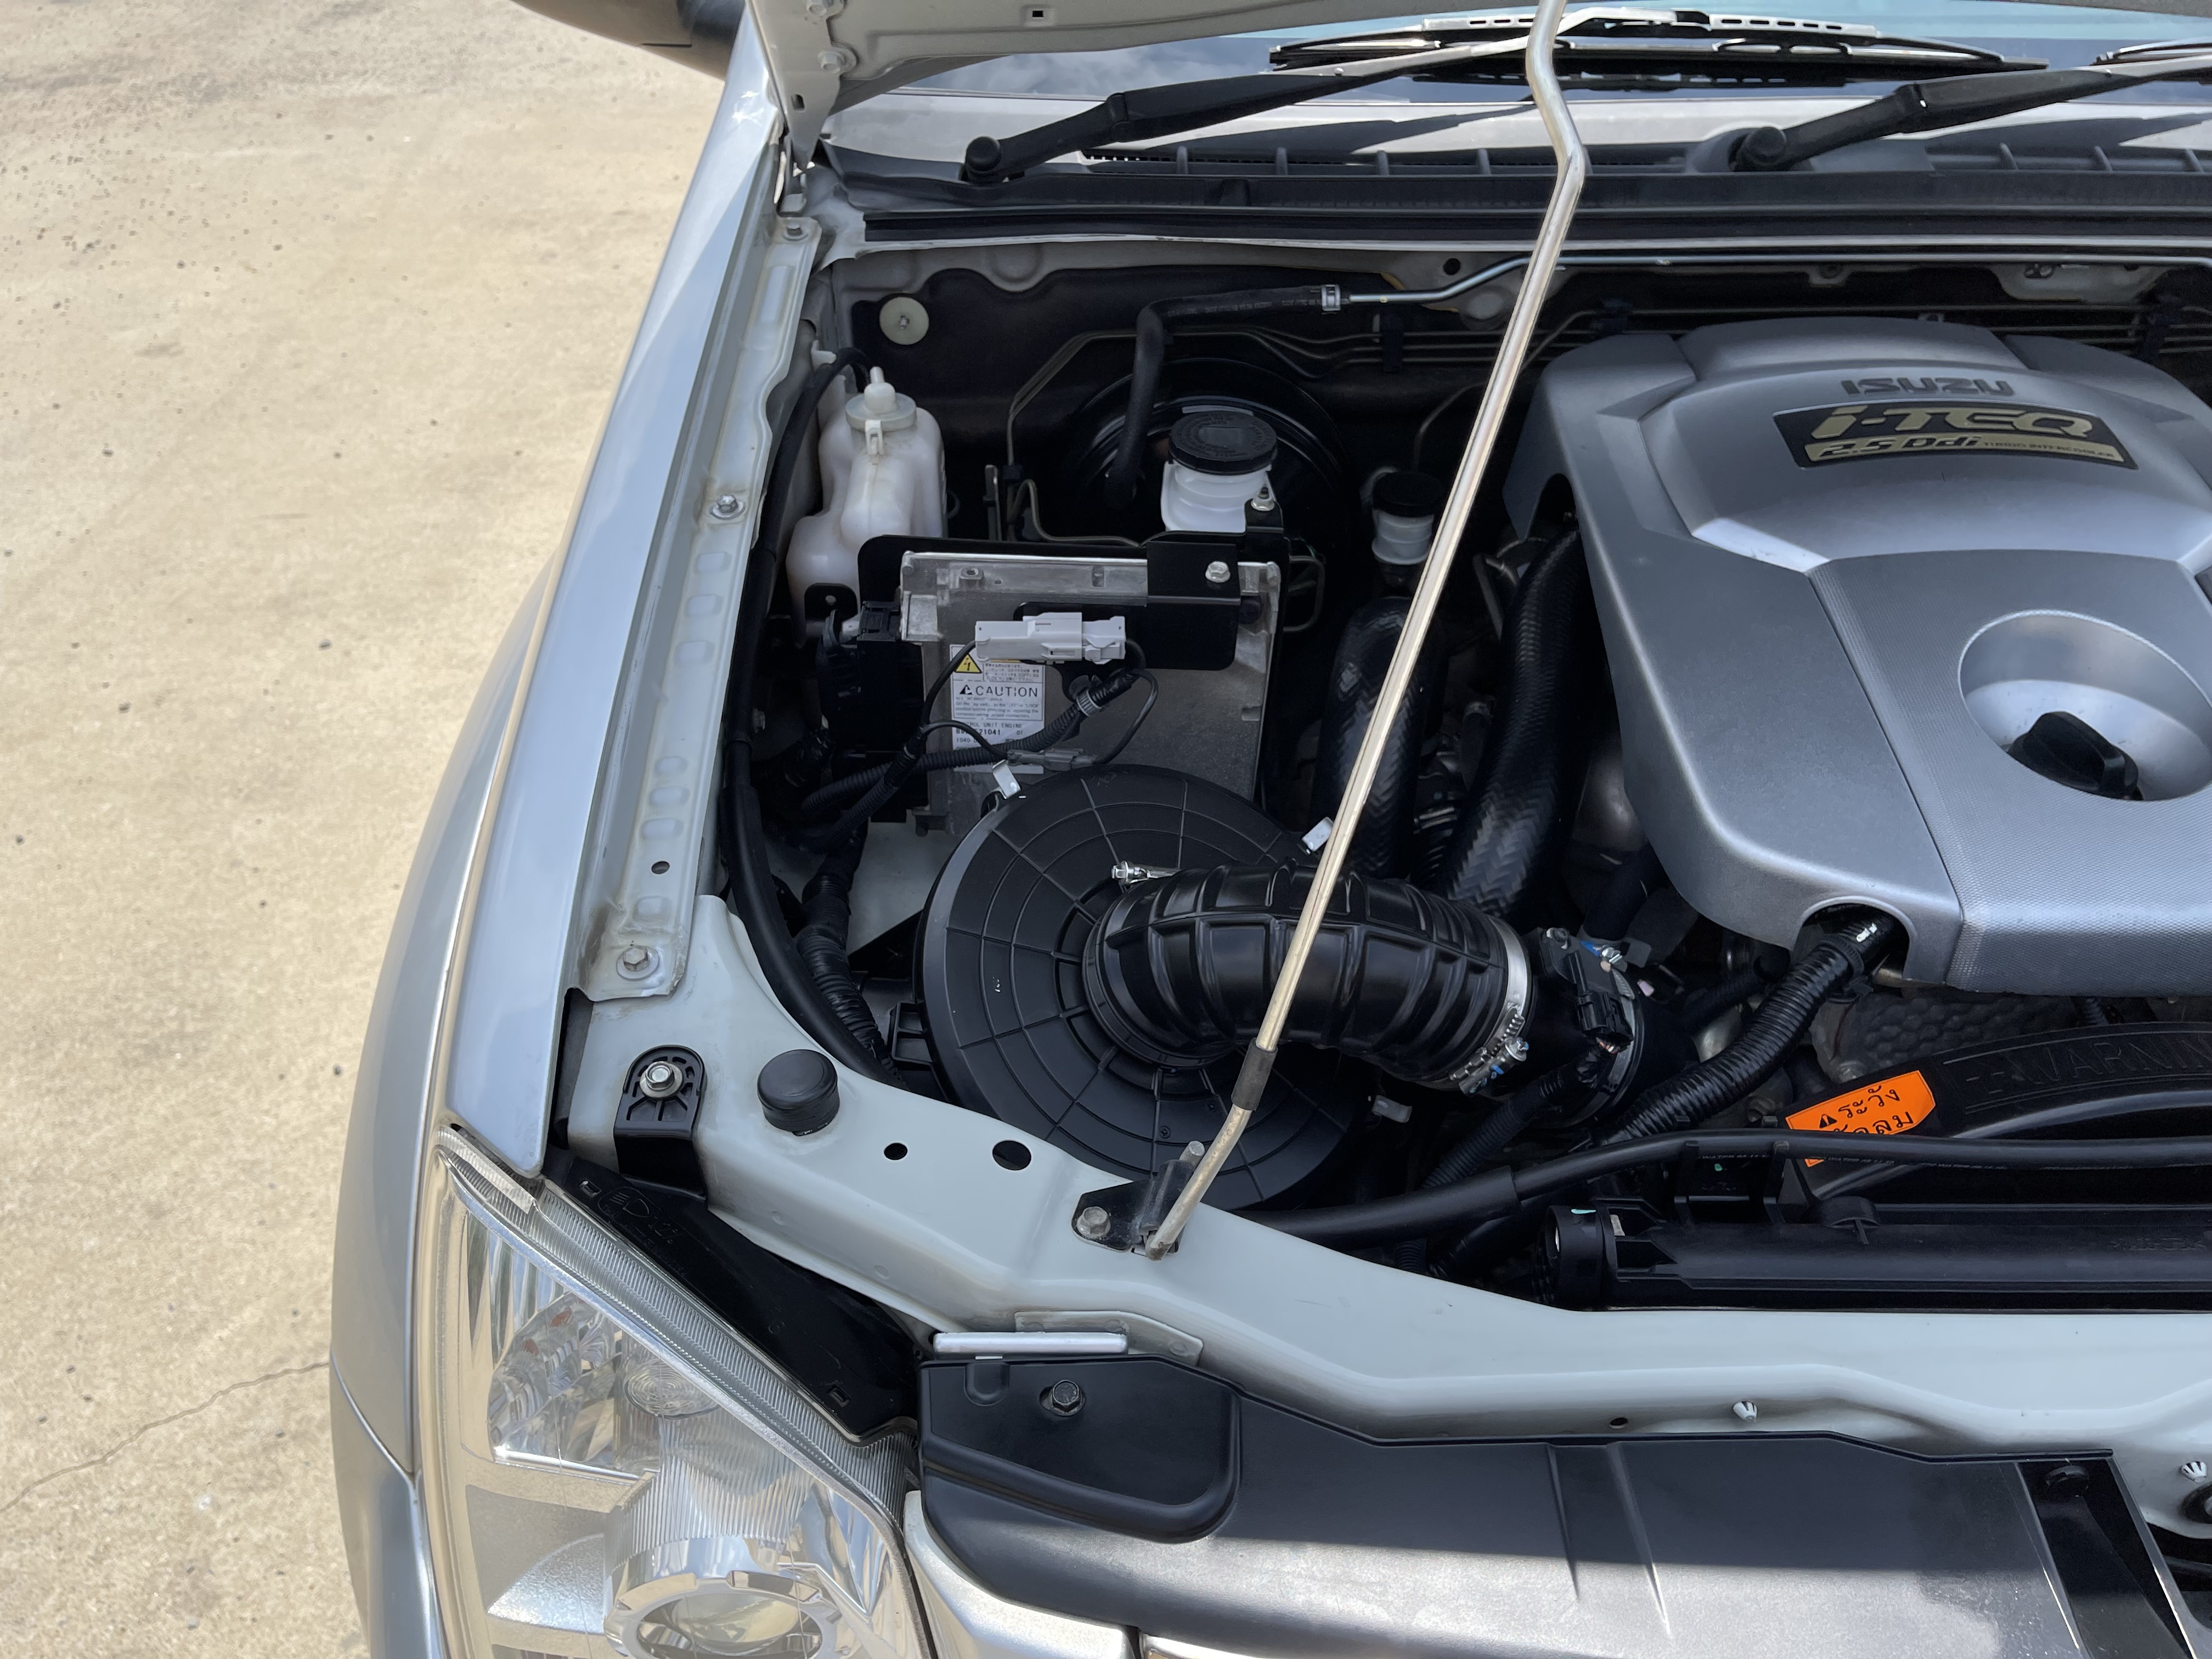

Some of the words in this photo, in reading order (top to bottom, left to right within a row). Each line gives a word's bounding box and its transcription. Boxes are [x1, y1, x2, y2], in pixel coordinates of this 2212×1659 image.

[1841, 377, 2015, 397] ISUZU
[975, 686, 1038, 697] CAUTION
[1837, 1085, 1901, 1118] ระวัง
